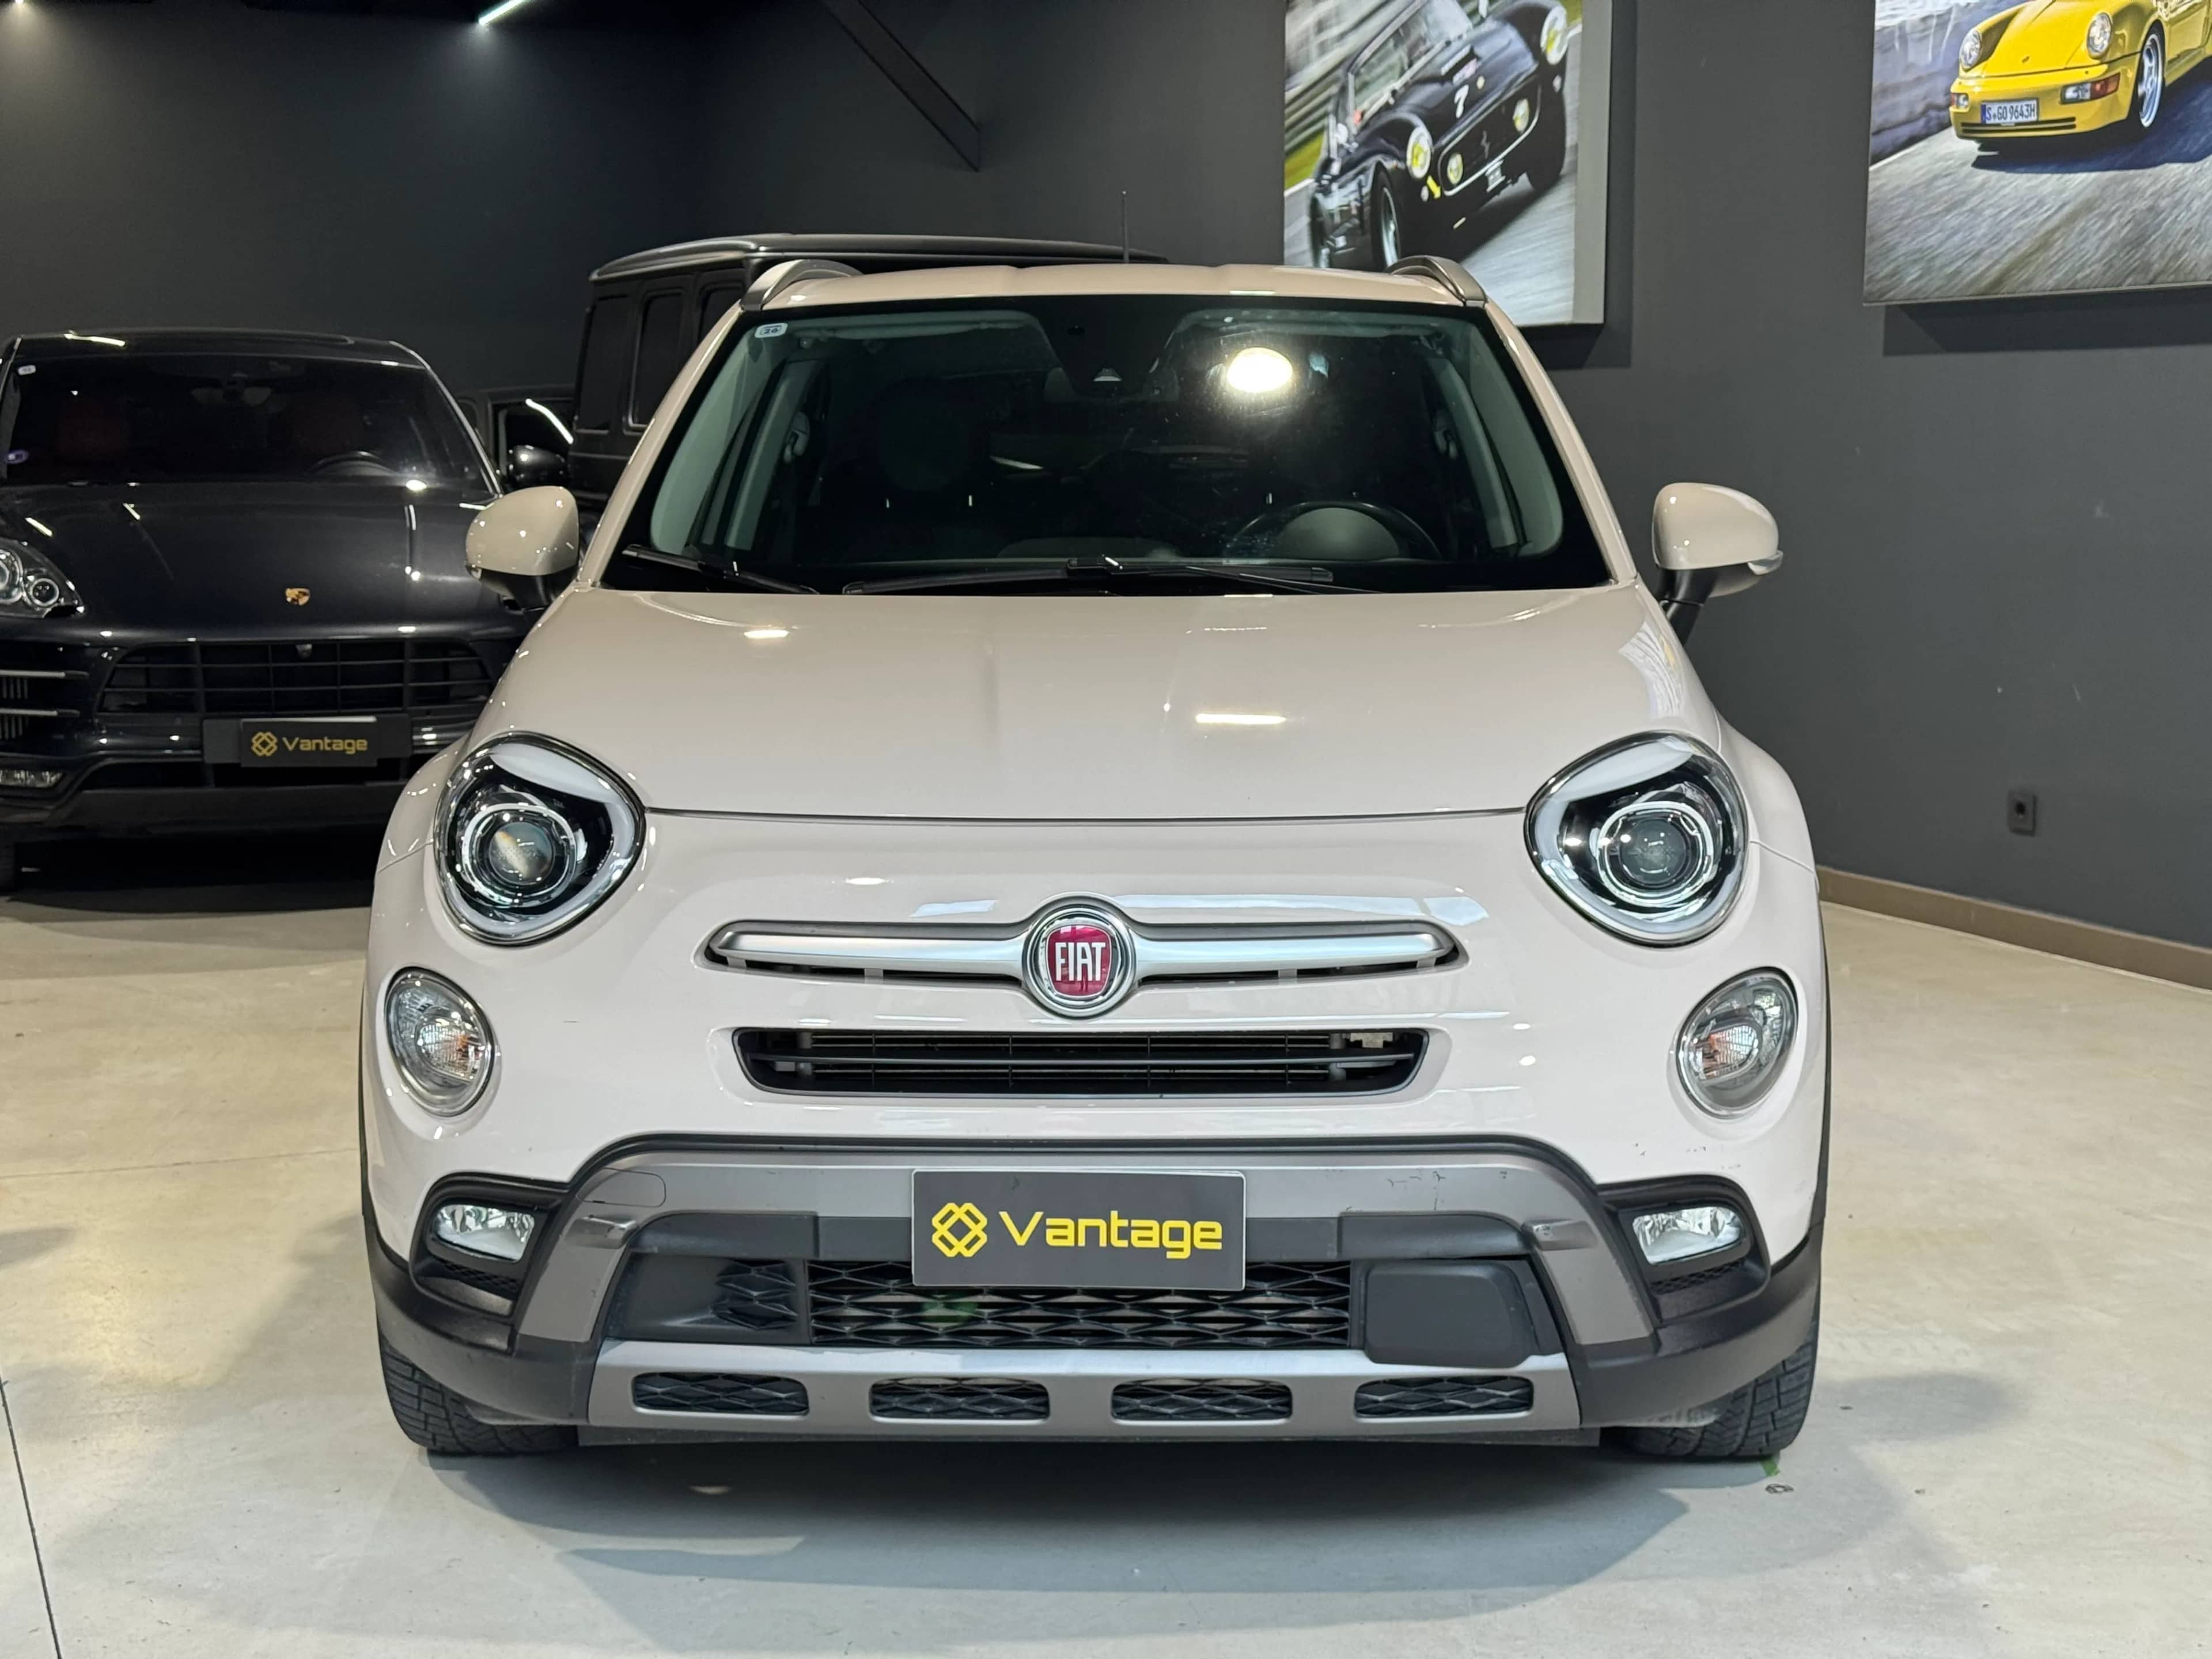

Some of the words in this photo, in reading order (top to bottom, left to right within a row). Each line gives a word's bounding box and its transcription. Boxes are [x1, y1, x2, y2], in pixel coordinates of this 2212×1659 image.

[282, 737, 368, 755] Vantage
[1055, 942, 1106, 982] FIAT
[998, 1210, 1223, 1260] Vantage
